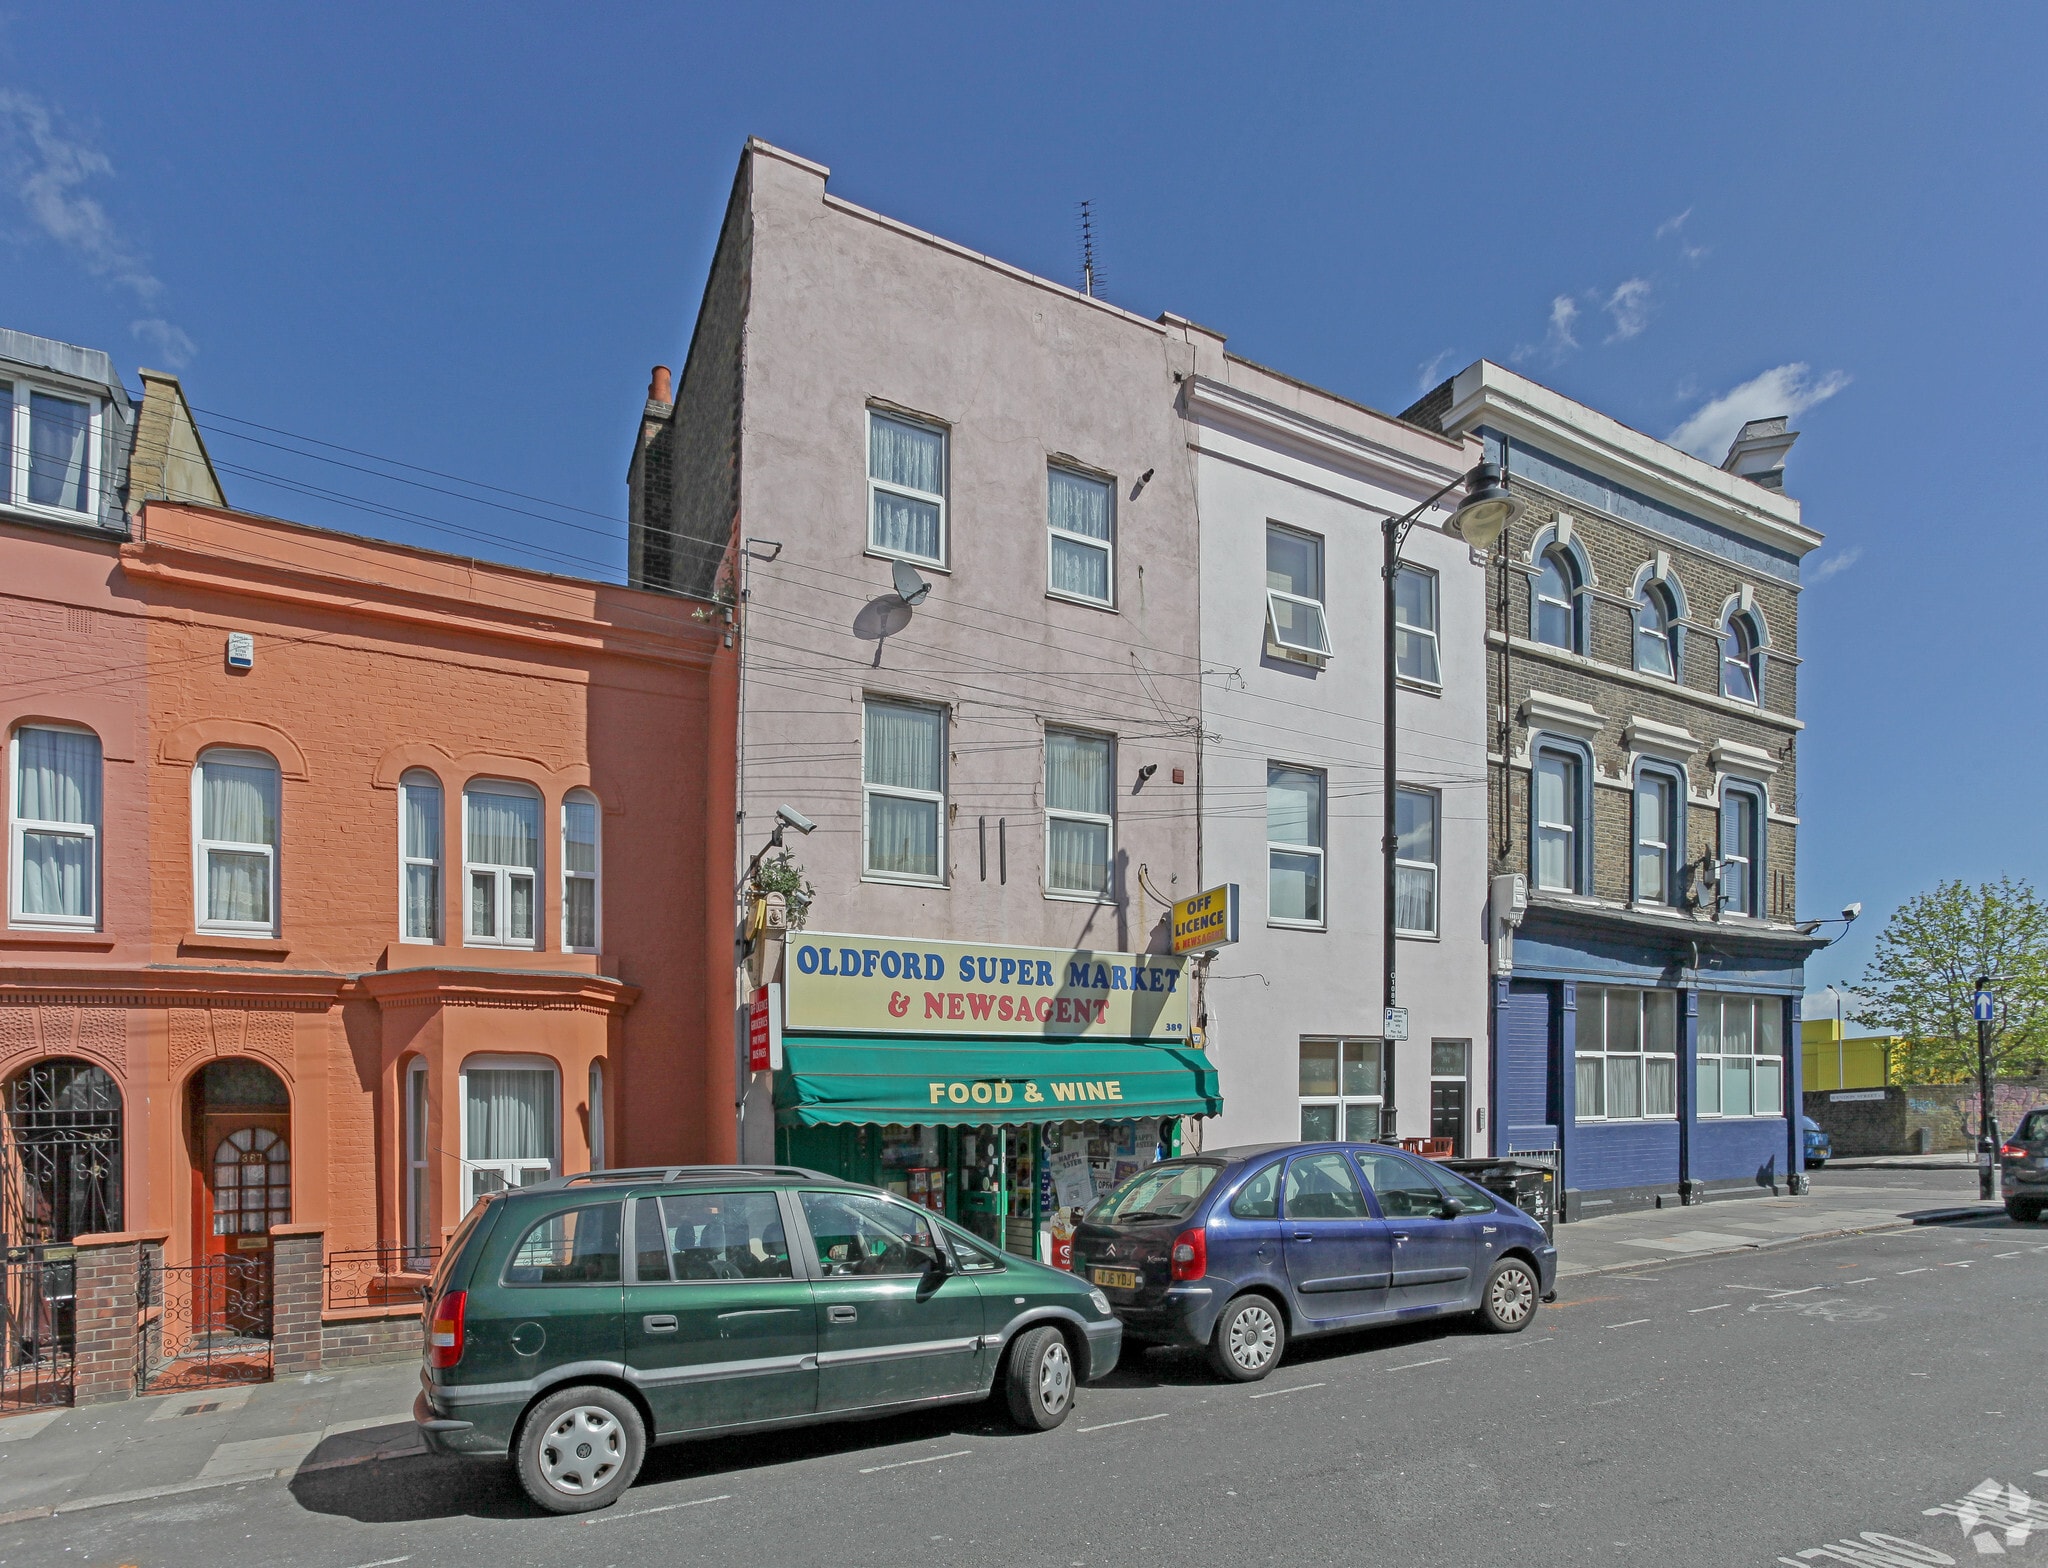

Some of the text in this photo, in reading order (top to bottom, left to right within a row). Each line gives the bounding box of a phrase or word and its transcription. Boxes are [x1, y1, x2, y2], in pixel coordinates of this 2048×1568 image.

[1187, 895, 1211, 915] OFF
[1175, 910, 1223, 937] LICENCE
[1175, 928, 1224, 951] & NEWSAGENT
[797, 945, 1180, 993] OLDFORD SUPER MARKET
[888, 991, 1110, 1024] & NEWSAGENT
[1165, 1023, 1183, 1032] 389
[929, 1081, 1123, 1104] FOOD & WINE
[1058, 1152, 1080, 1162] HAPPY
[1117, 1273, 1132, 1286] YDJ
